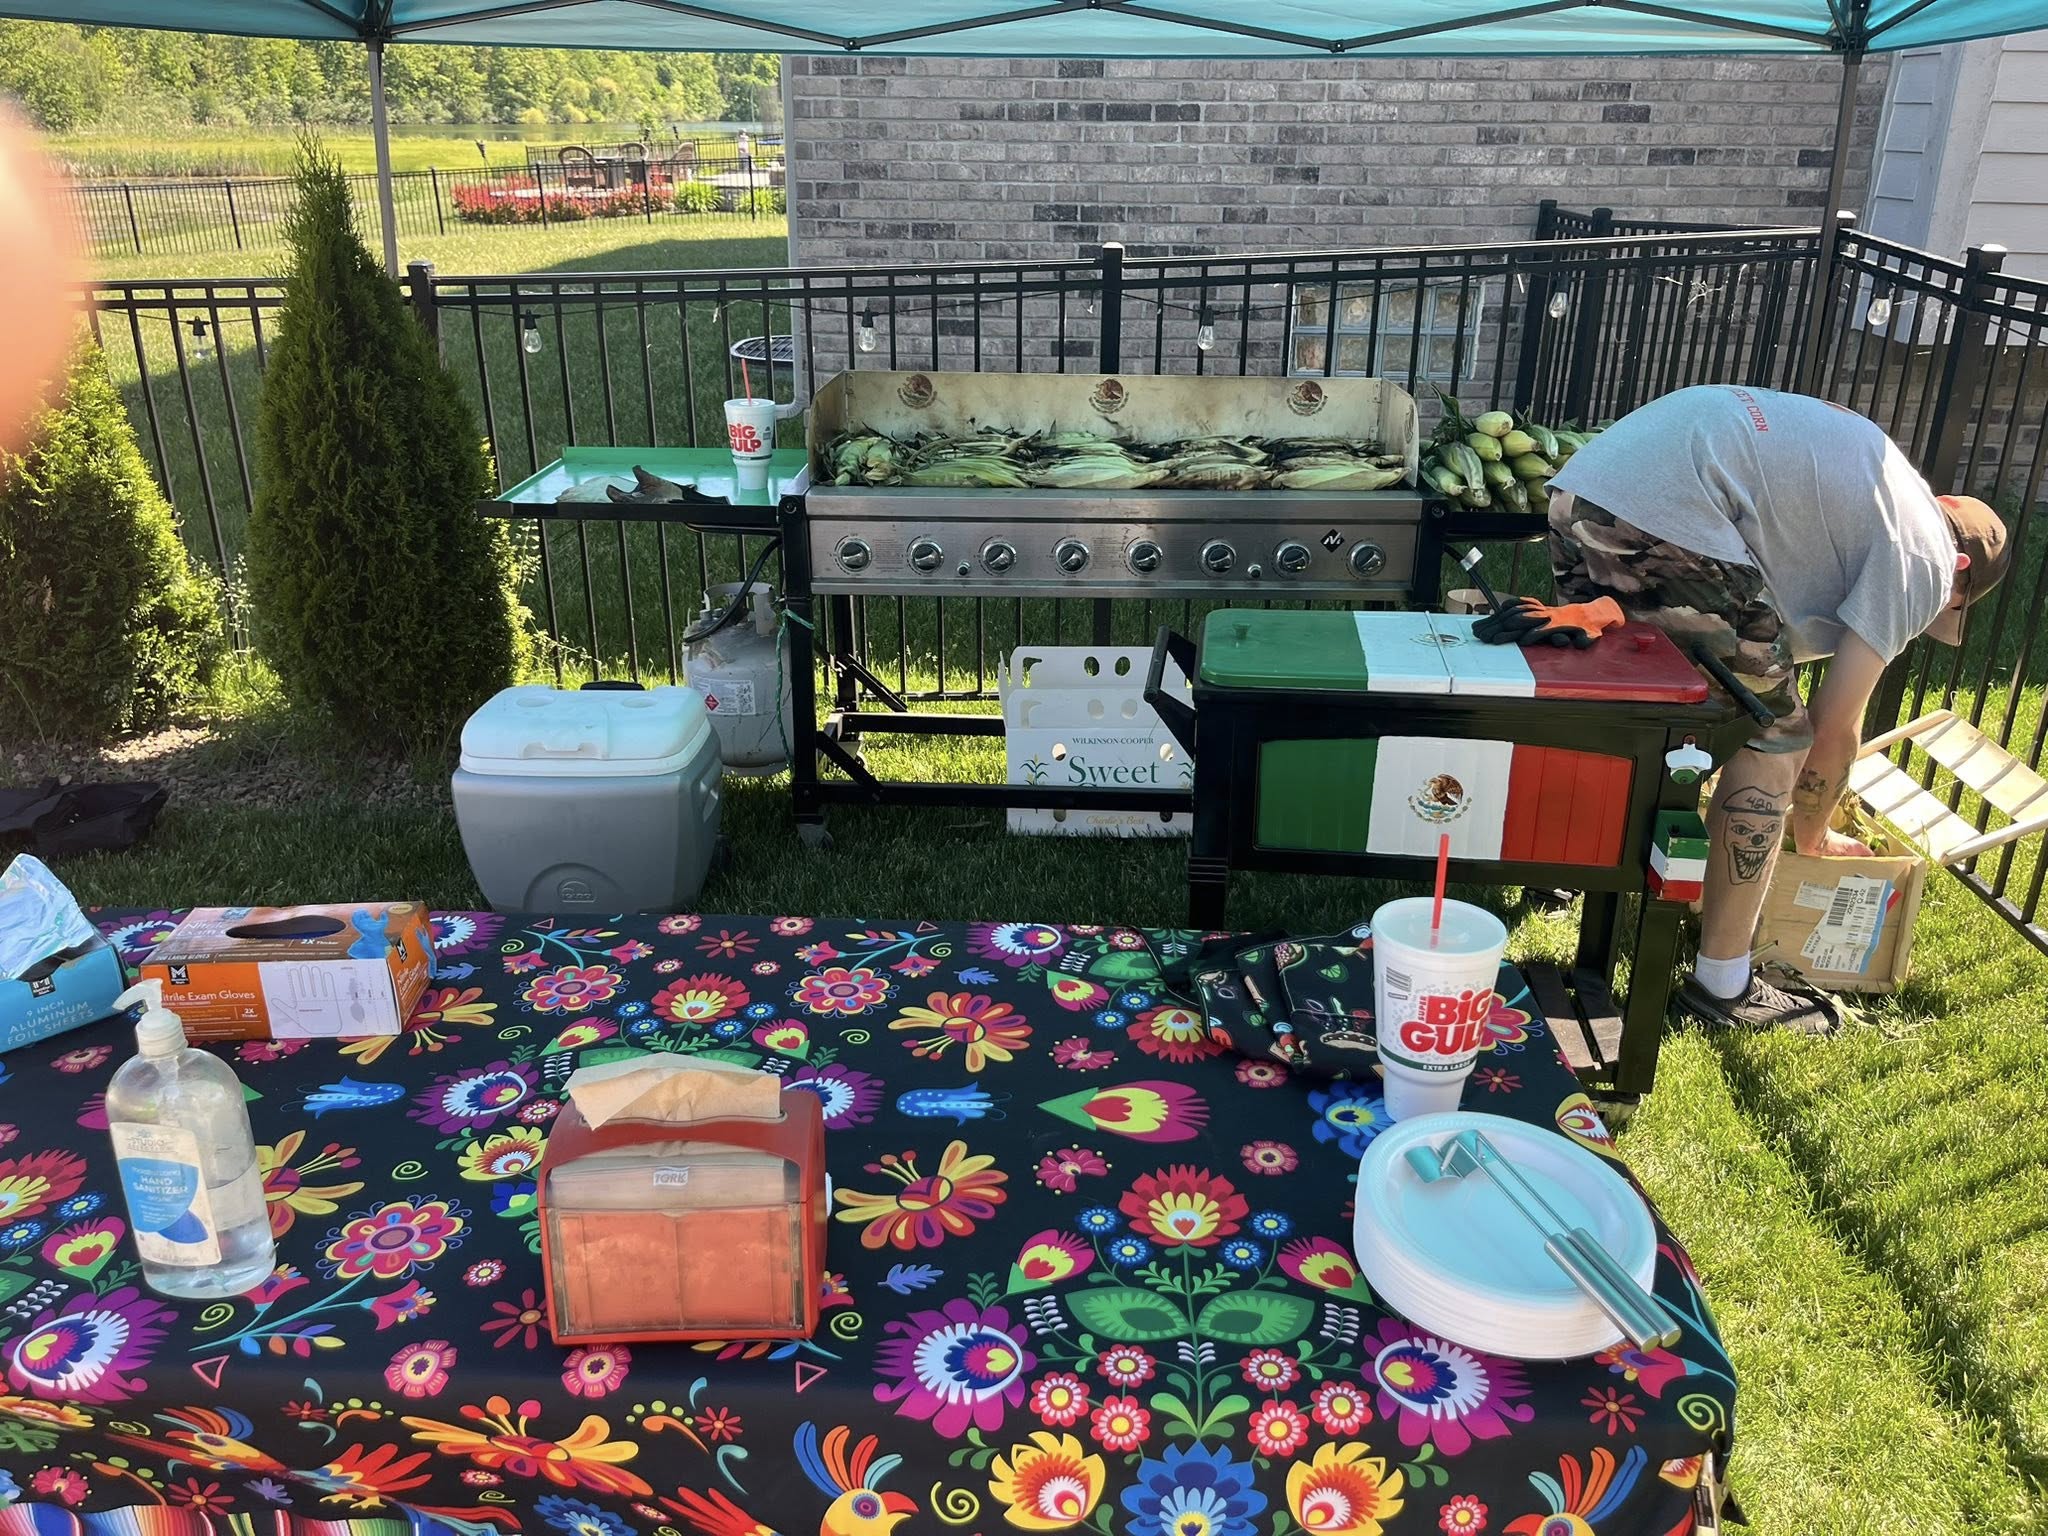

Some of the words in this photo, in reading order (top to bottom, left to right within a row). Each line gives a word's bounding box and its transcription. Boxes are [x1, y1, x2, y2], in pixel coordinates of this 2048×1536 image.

[1746, 405, 1769, 432] CORN
[1068, 755, 1160, 784] Sweet
[1745, 795, 1773, 811] 420
[162, 989, 186, 1001] itrile
[188, 991, 217, 1001] Exam
[219, 989, 256, 999] Gloves
[36, 1000, 65, 1015] INCH
[9, 1001, 89, 1035] ALUMINUM
[7, 1030, 40, 1046] FOIL
[44, 1007, 95, 1033] SHEETS
[141, 1175, 173, 1186] HAND
[655, 1172, 688, 1184] TORK
[132, 1181, 189, 1195] SANITIZER
